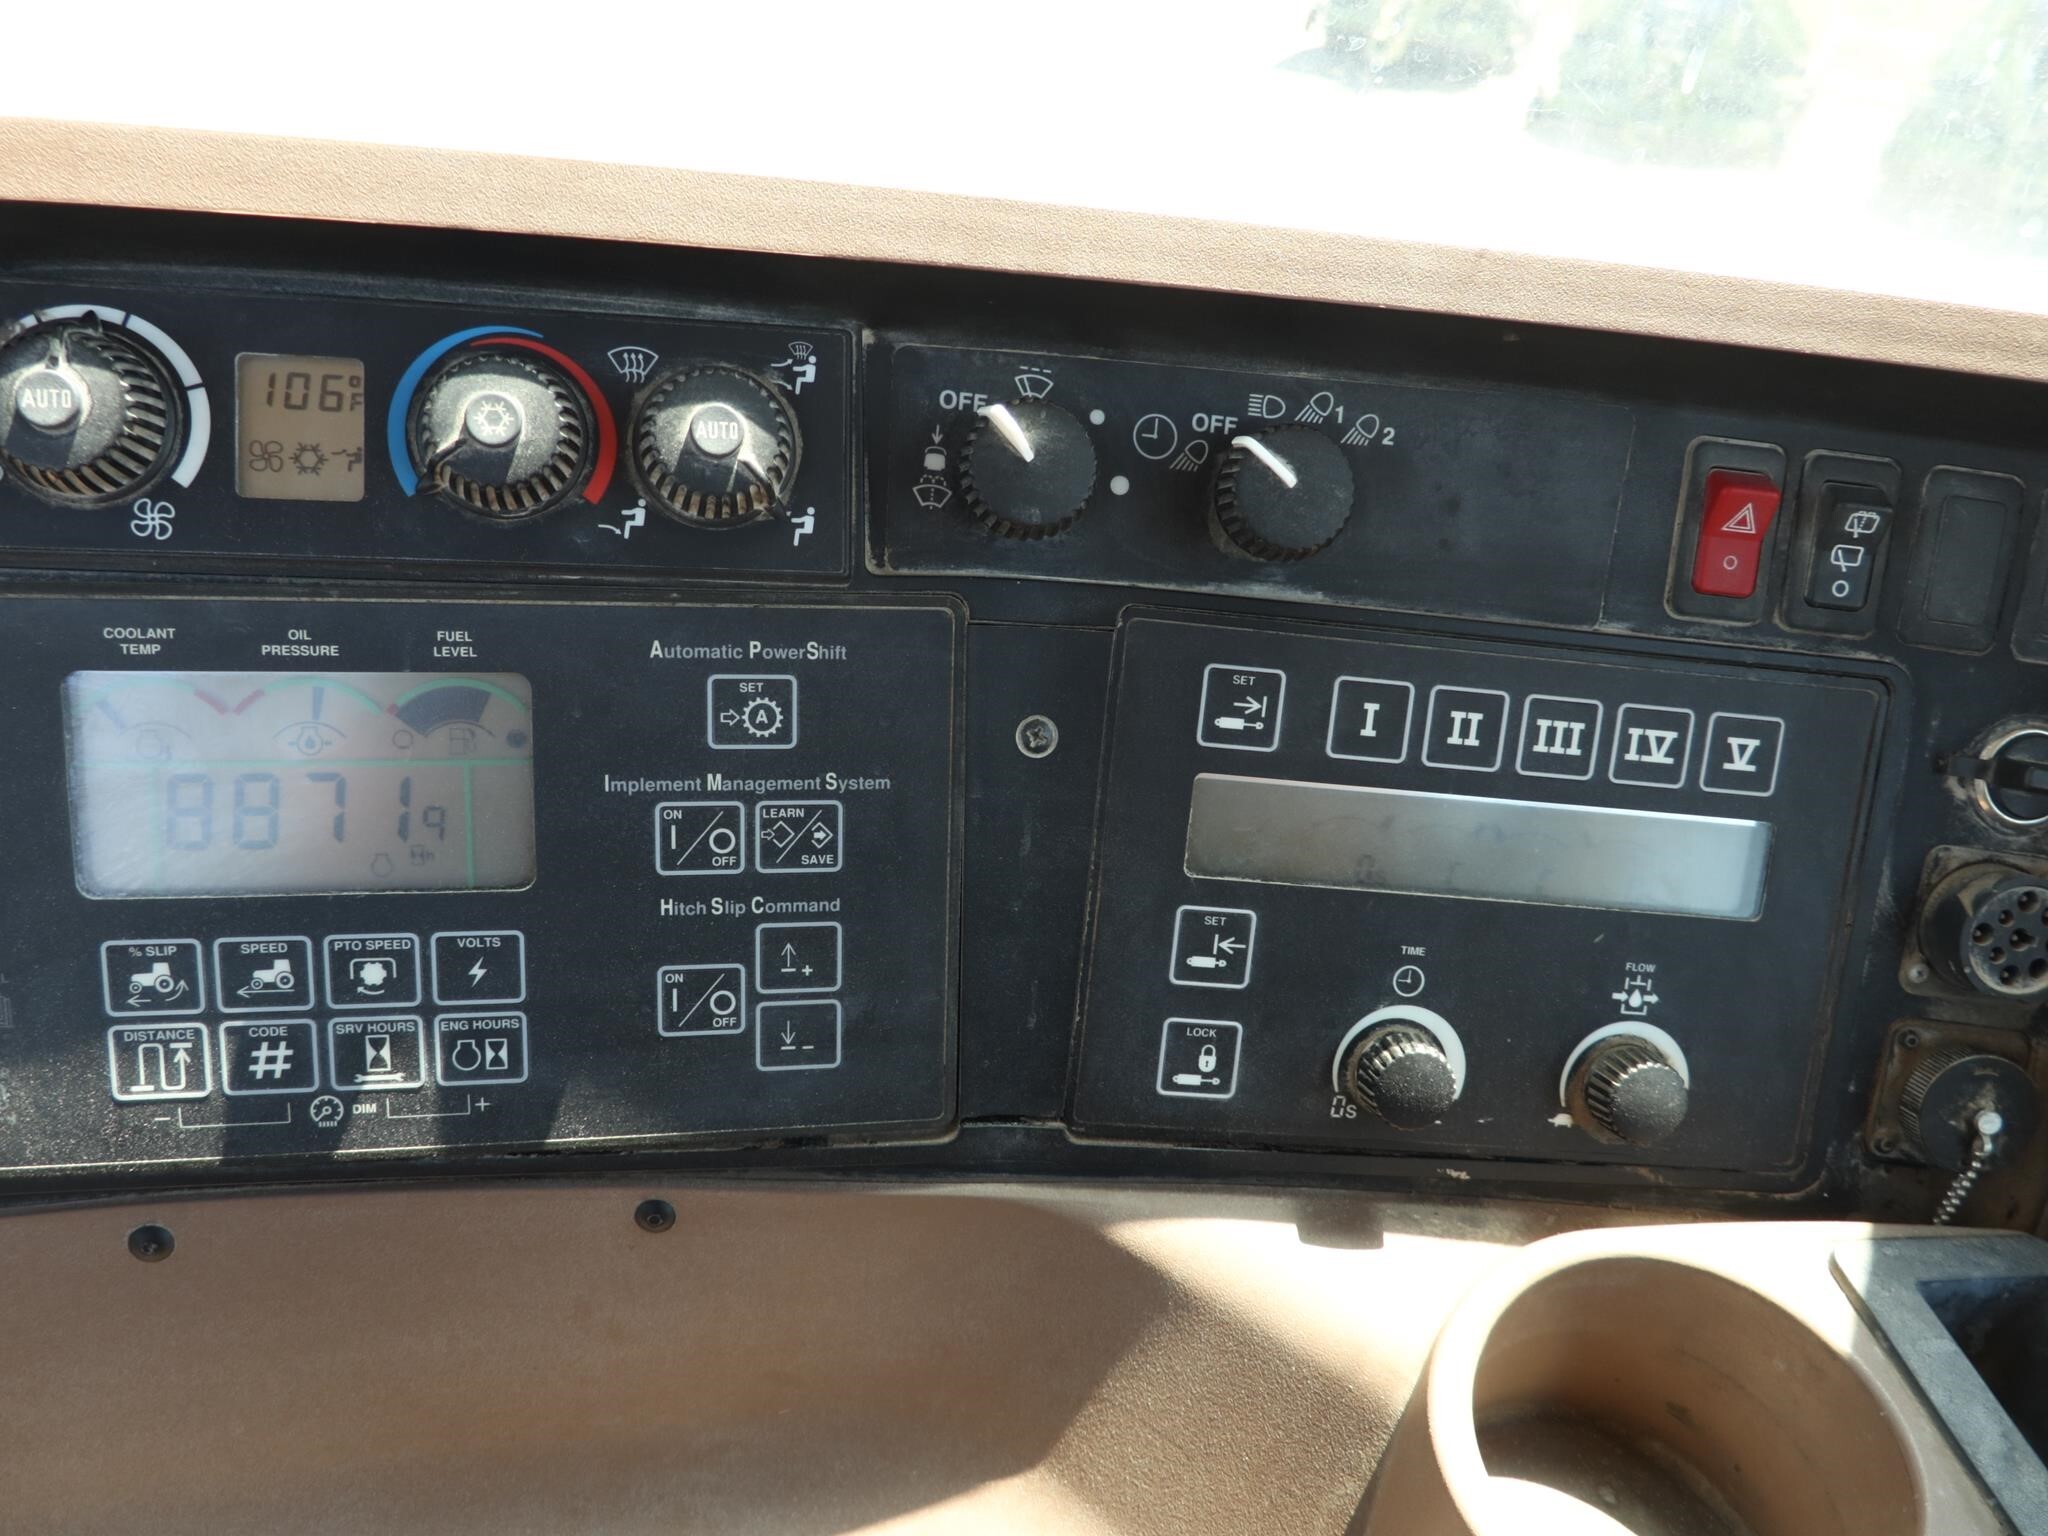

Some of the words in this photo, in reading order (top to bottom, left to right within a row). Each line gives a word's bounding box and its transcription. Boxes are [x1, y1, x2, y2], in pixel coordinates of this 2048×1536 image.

[21, 387, 72, 410] AUTO
[938, 389, 988, 412] OFF
[1336, 405, 1344, 424] 1
[696, 420, 739, 439] AUTO
[1191, 412, 1239, 435] OFF
[1381, 426, 1396, 446] 2
[103, 627, 176, 639] COOLANT
[287, 629, 312, 641] OIL
[436, 630, 473, 642] FUEL
[119, 643, 161, 655] TEMP
[261, 644, 340, 657] PRESSURE
[433, 646, 478, 658] LEVEL
[649, 639, 743, 659] Automatic
[749, 640, 847, 660] PowerShift
[1232, 674, 1256, 686] SET
[739, 682, 764, 693] SET
[755, 709, 769, 724] A
[1446, 710, 1484, 747] II
[1532, 718, 1586, 756] III
[1624, 727, 1679, 765] IV
[1722, 736, 1761, 772] V
[604, 774, 702, 796] Implement
[706, 773, 821, 795] Management
[825, 772, 891, 794] System
[663, 809, 683, 820] ON
[762, 807, 805, 819] LEARN
[711, 855, 737, 867] OFF
[801, 854, 834, 865] SAVE
[660, 898, 707, 916] Hitch
[711, 897, 746, 918] Slip
[751, 895, 841, 914] Command
[1204, 915, 1227, 926] SET
[240, 942, 288, 954] SPEED
[333, 940, 362, 952] PTO
[365, 939, 412, 951] SPEED
[456, 936, 502, 948] VOLTS
[145, 945, 177, 957] SLIP
[1401, 945, 1426, 957] TIME
[1625, 961, 1656, 973] FLOW
[664, 973, 684, 984] ON
[334, 1021, 364, 1035] SRV
[366, 1019, 416, 1033] HOURS
[440, 1020, 469, 1032] ENG
[472, 1018, 520, 1030] HOURS
[712, 1016, 737, 1028] OFF
[122, 1028, 196, 1042] DISTANCE
[248, 1025, 288, 1038] CODE
[1186, 1027, 1217, 1038] LOCK
[352, 1102, 377, 1115] DIM
